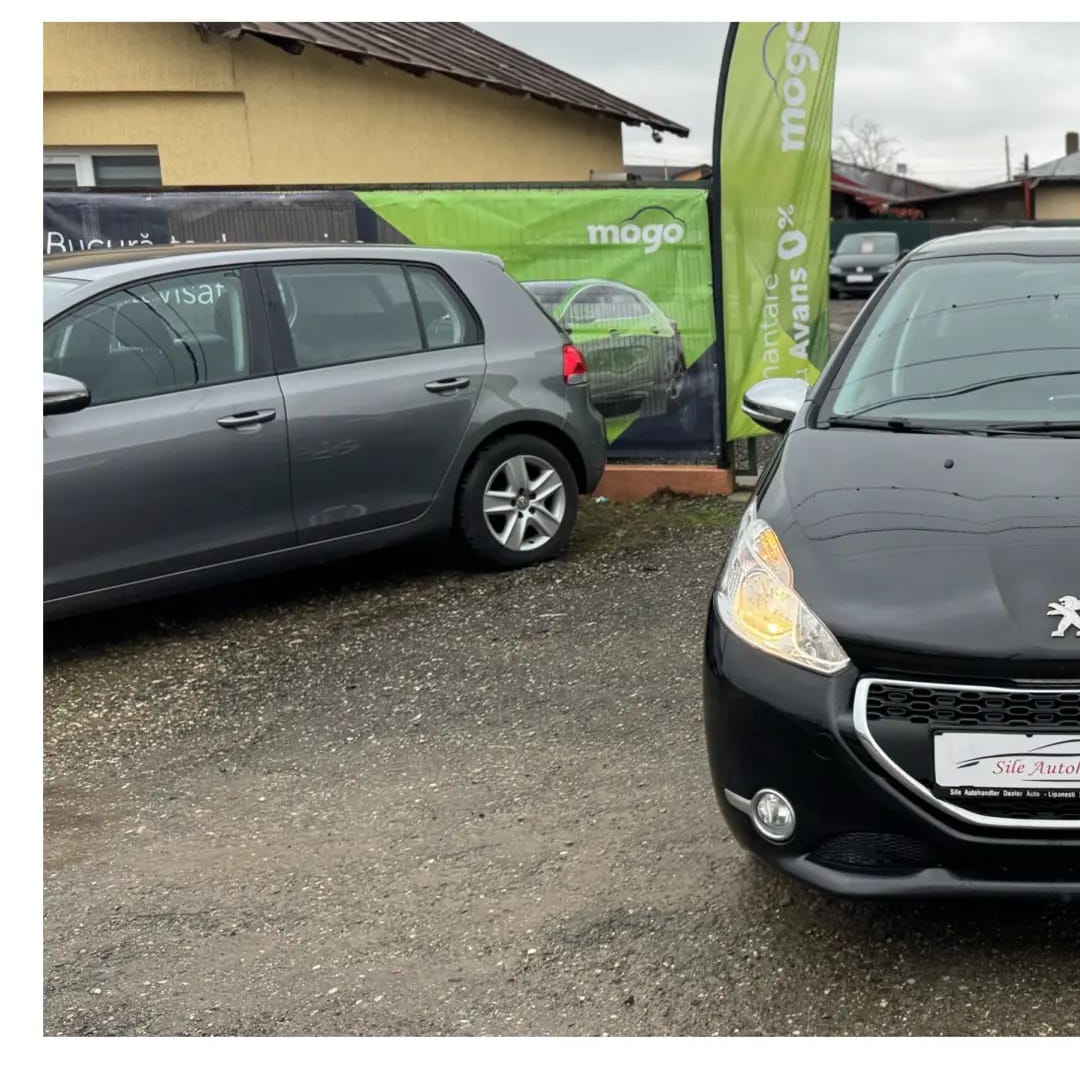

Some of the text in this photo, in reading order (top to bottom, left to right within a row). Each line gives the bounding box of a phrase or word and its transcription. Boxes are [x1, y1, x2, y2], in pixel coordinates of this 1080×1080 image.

[781, 22, 820, 152] mogo
[587, 223, 684, 254] mogo
[777, 204, 807, 260] 0%
[789, 267, 810, 360] Avans
[992, 759, 1025, 775] Sile
[964, 789, 1000, 797] Autohandler
[1003, 790, 1023, 798] Dealer
